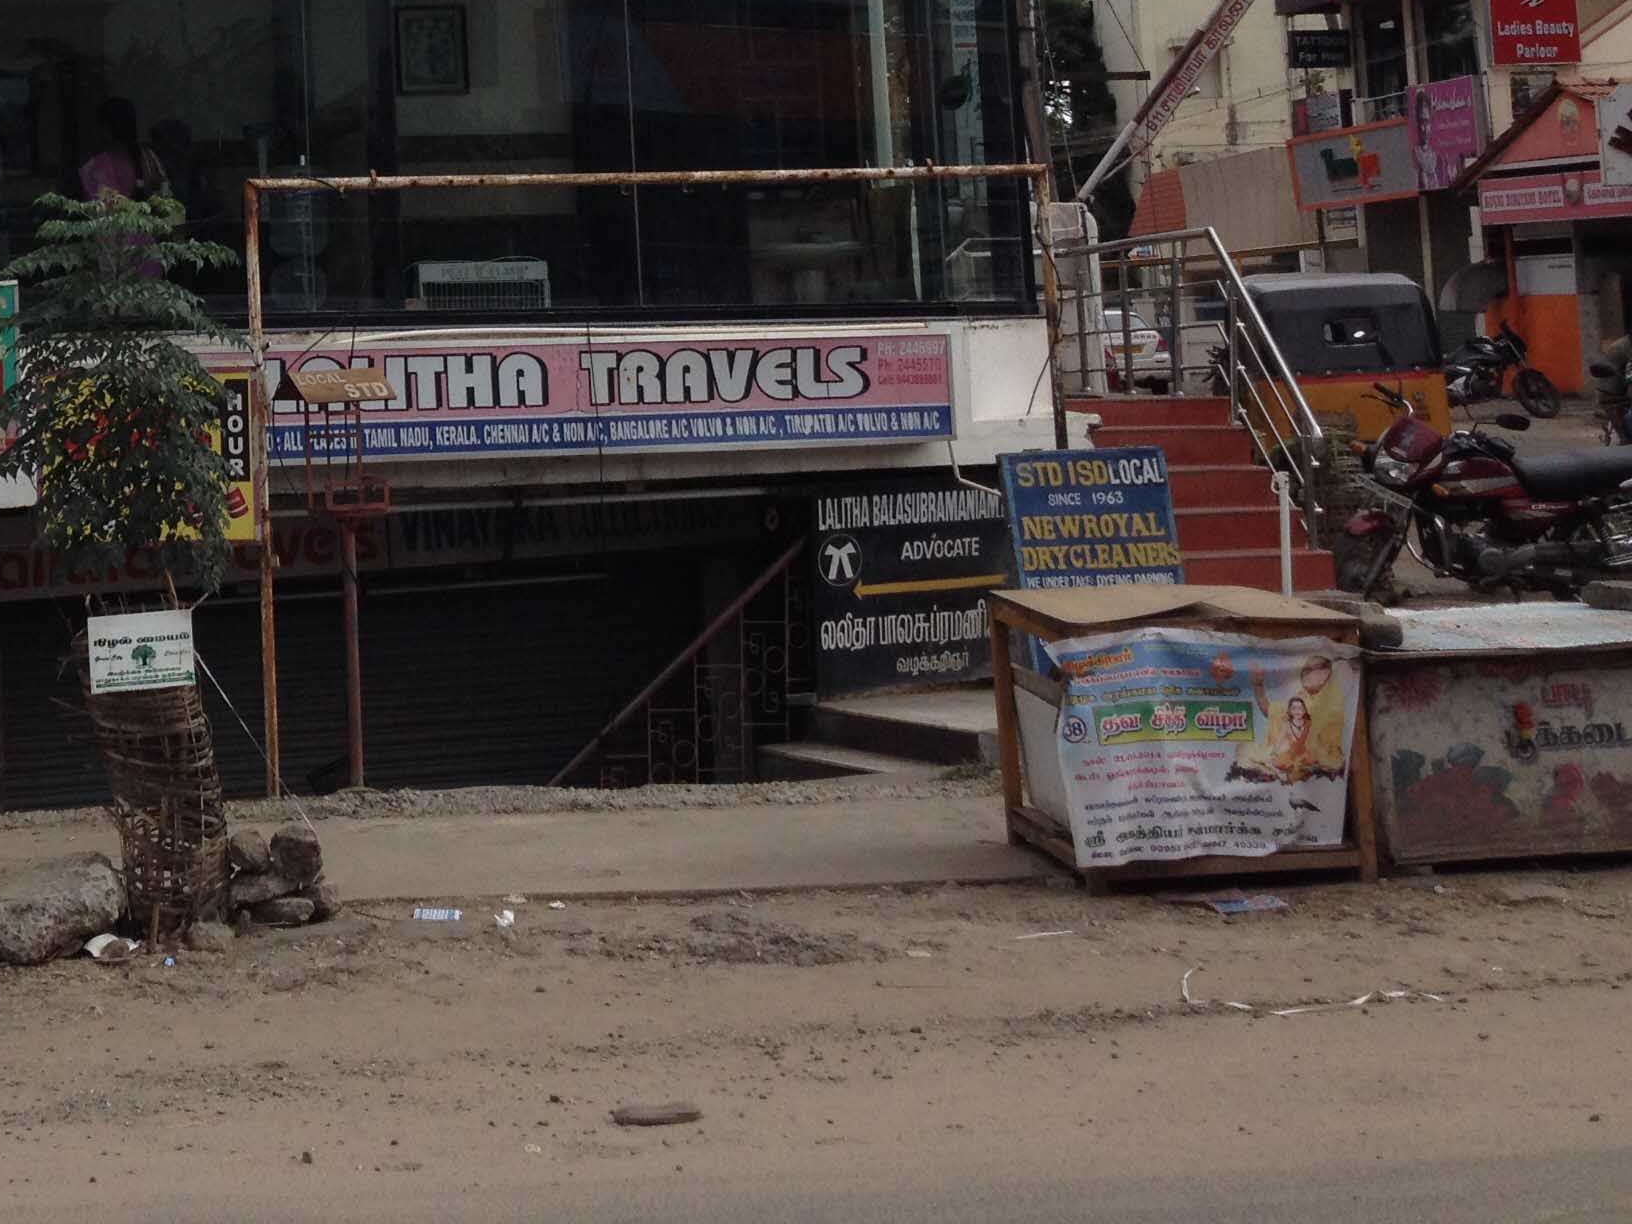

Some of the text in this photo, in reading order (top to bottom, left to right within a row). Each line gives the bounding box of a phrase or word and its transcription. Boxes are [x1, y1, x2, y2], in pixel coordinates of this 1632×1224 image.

[1496, 19, 1575, 39] Ladies Beauty
[1516, 43, 1559, 58] Parlour
[297, 374, 347, 387] LOCAL
[343, 381, 390, 399] STD
[579, 345, 871, 407] TRAVELS
[226, 391, 245, 477] HOUR
[283, 434, 303, 452] ALL
[365, 430, 398, 449] TAMIL
[399, 428, 433, 451] NADU,
[436, 427, 481, 446] KERALA.
[483, 426, 529, 445] CHENNAI
[531, 425, 549, 443] A/C
[563, 424, 585, 441] NON
[610, 419, 669, 441] BANGALORE
[672, 418, 689, 438] A/C
[690, 417, 723, 437] VOLVO
[736, 416, 757, 435] NON
[839, 414, 855, 432] A/C
[856, 413, 888, 432] VOLVO
[901, 412, 921, 430] NON
[923, 411, 941, 430] A/C
[1015, 457, 1165, 488] STD ISD LOCAL
[818, 495, 870, 531] LALITHA
[1048, 491, 1124, 507] SINCE 1963
[900, 536, 981, 561] ADVOCATE
[820, 611, 875, 652] லலிதா
